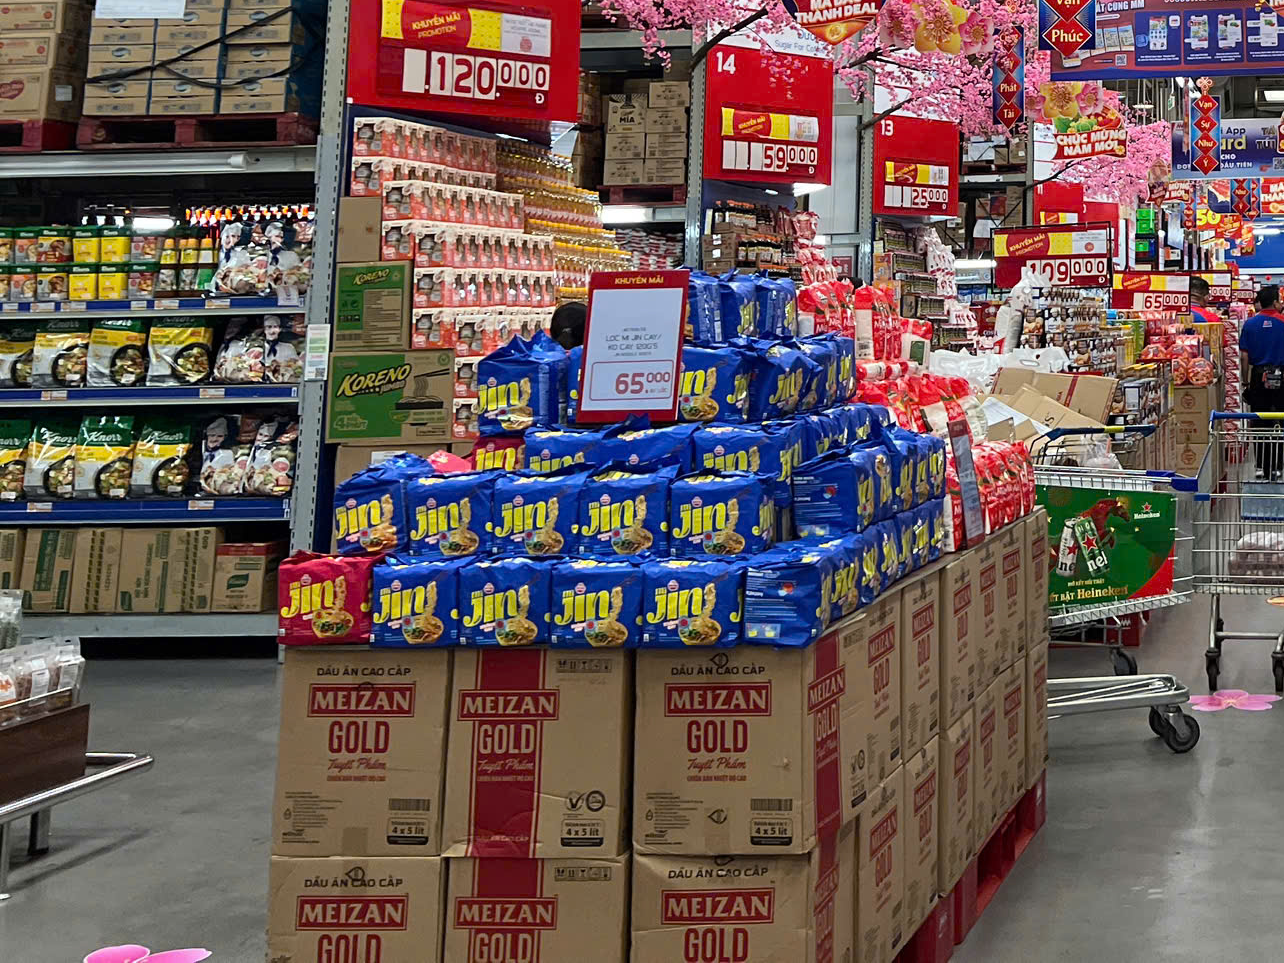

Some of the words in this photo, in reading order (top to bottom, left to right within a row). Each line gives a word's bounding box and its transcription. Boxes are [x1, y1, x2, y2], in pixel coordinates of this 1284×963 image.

[843, 2, 879, 16] DEAL
[1051, 27, 1084, 44] Phúc
[716, 51, 737, 75] 14
[880, 119, 895, 137] 13
[353, 269, 390, 285] KORENO
[337, 364, 411, 397] KORENO
[361, 667, 384, 676] CAO
[670, 689, 766, 710] MEIZAN
[808, 668, 846, 710] MEIZAN
[313, 690, 412, 711] MEIZAN
[463, 696, 555, 715] MEIZAN
[328, 720, 390, 754] GOLD
[478, 724, 536, 754] GOLD
[687, 719, 749, 754] GOLD
[302, 902, 404, 924] MEIZAN
